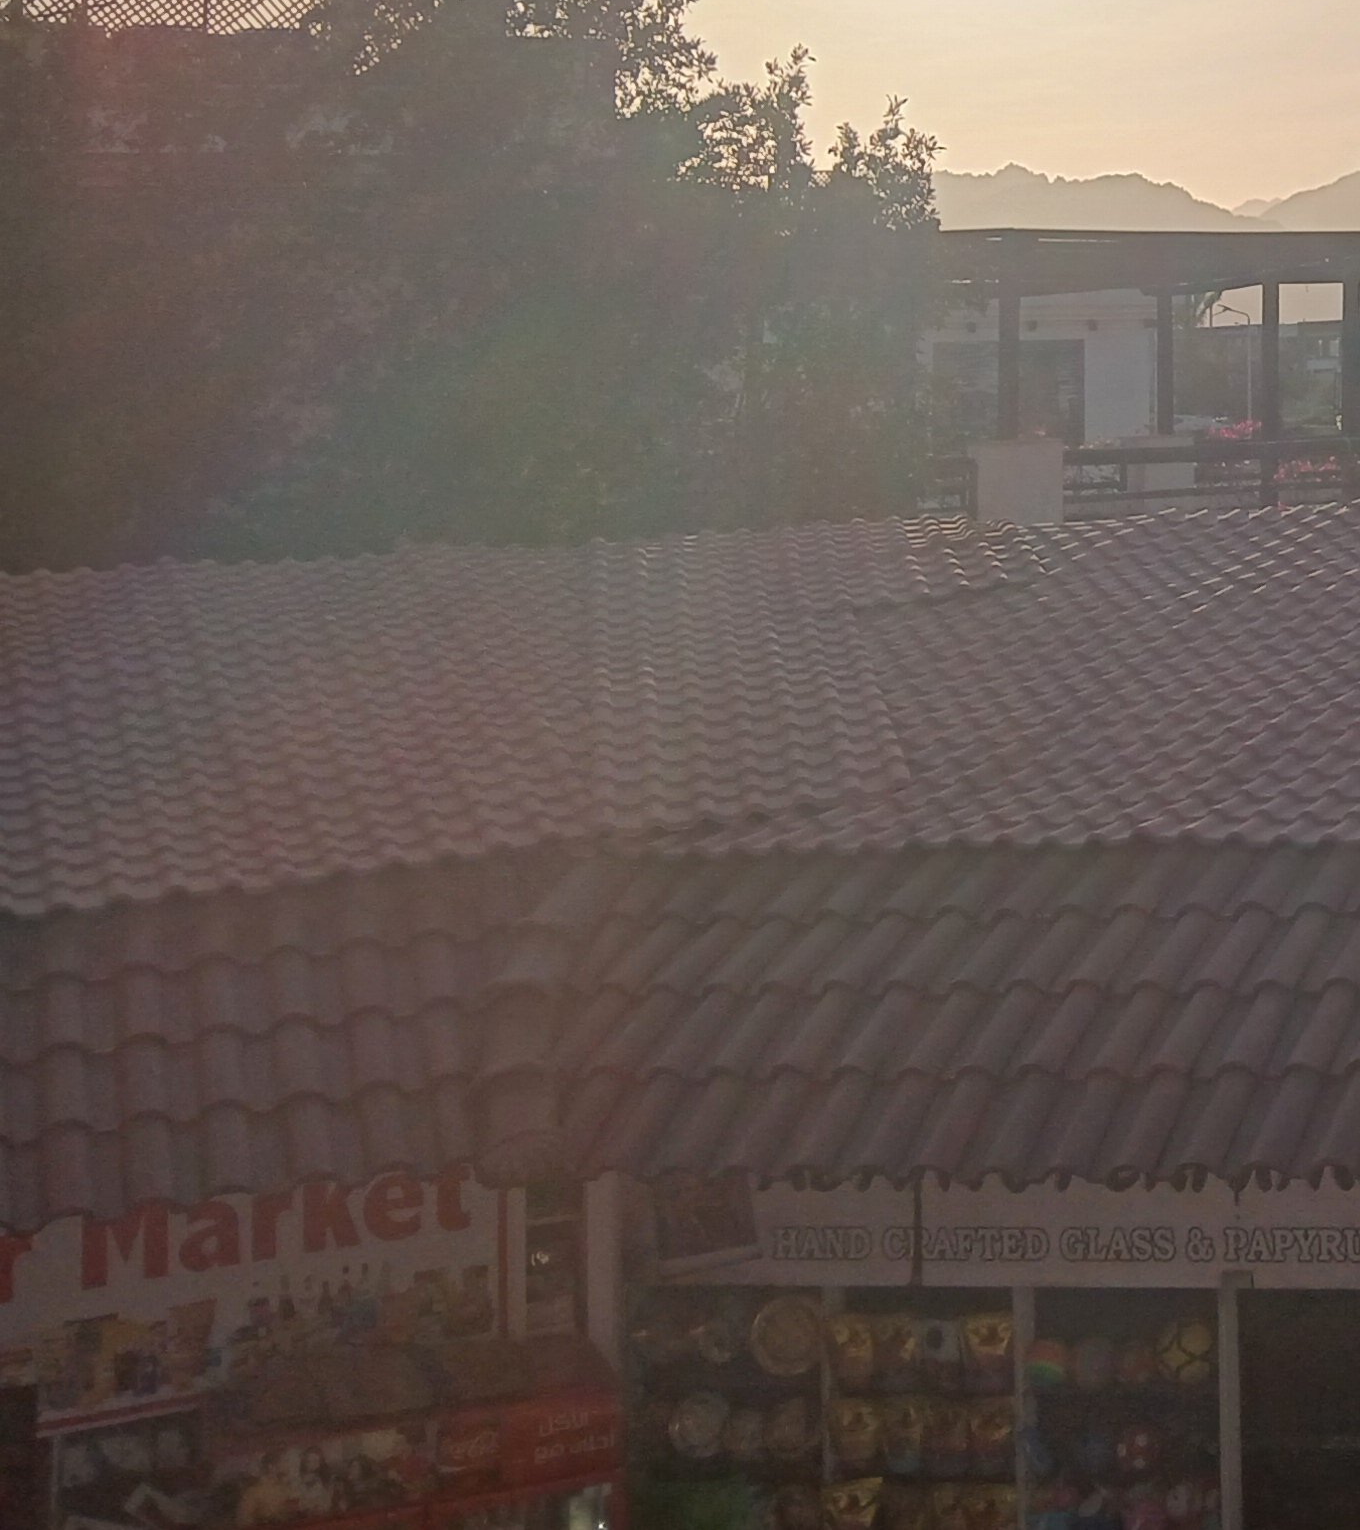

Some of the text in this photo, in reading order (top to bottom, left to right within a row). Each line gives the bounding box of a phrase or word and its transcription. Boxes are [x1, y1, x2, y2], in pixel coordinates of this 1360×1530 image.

[81, 1164, 473, 1289] Market
[772, 1226, 870, 1262] HAND
[879, 1226, 1048, 1262] CRAFTED
[1060, 1226, 1175, 1263] GLASS
[1187, 1227, 1214, 1262] &
